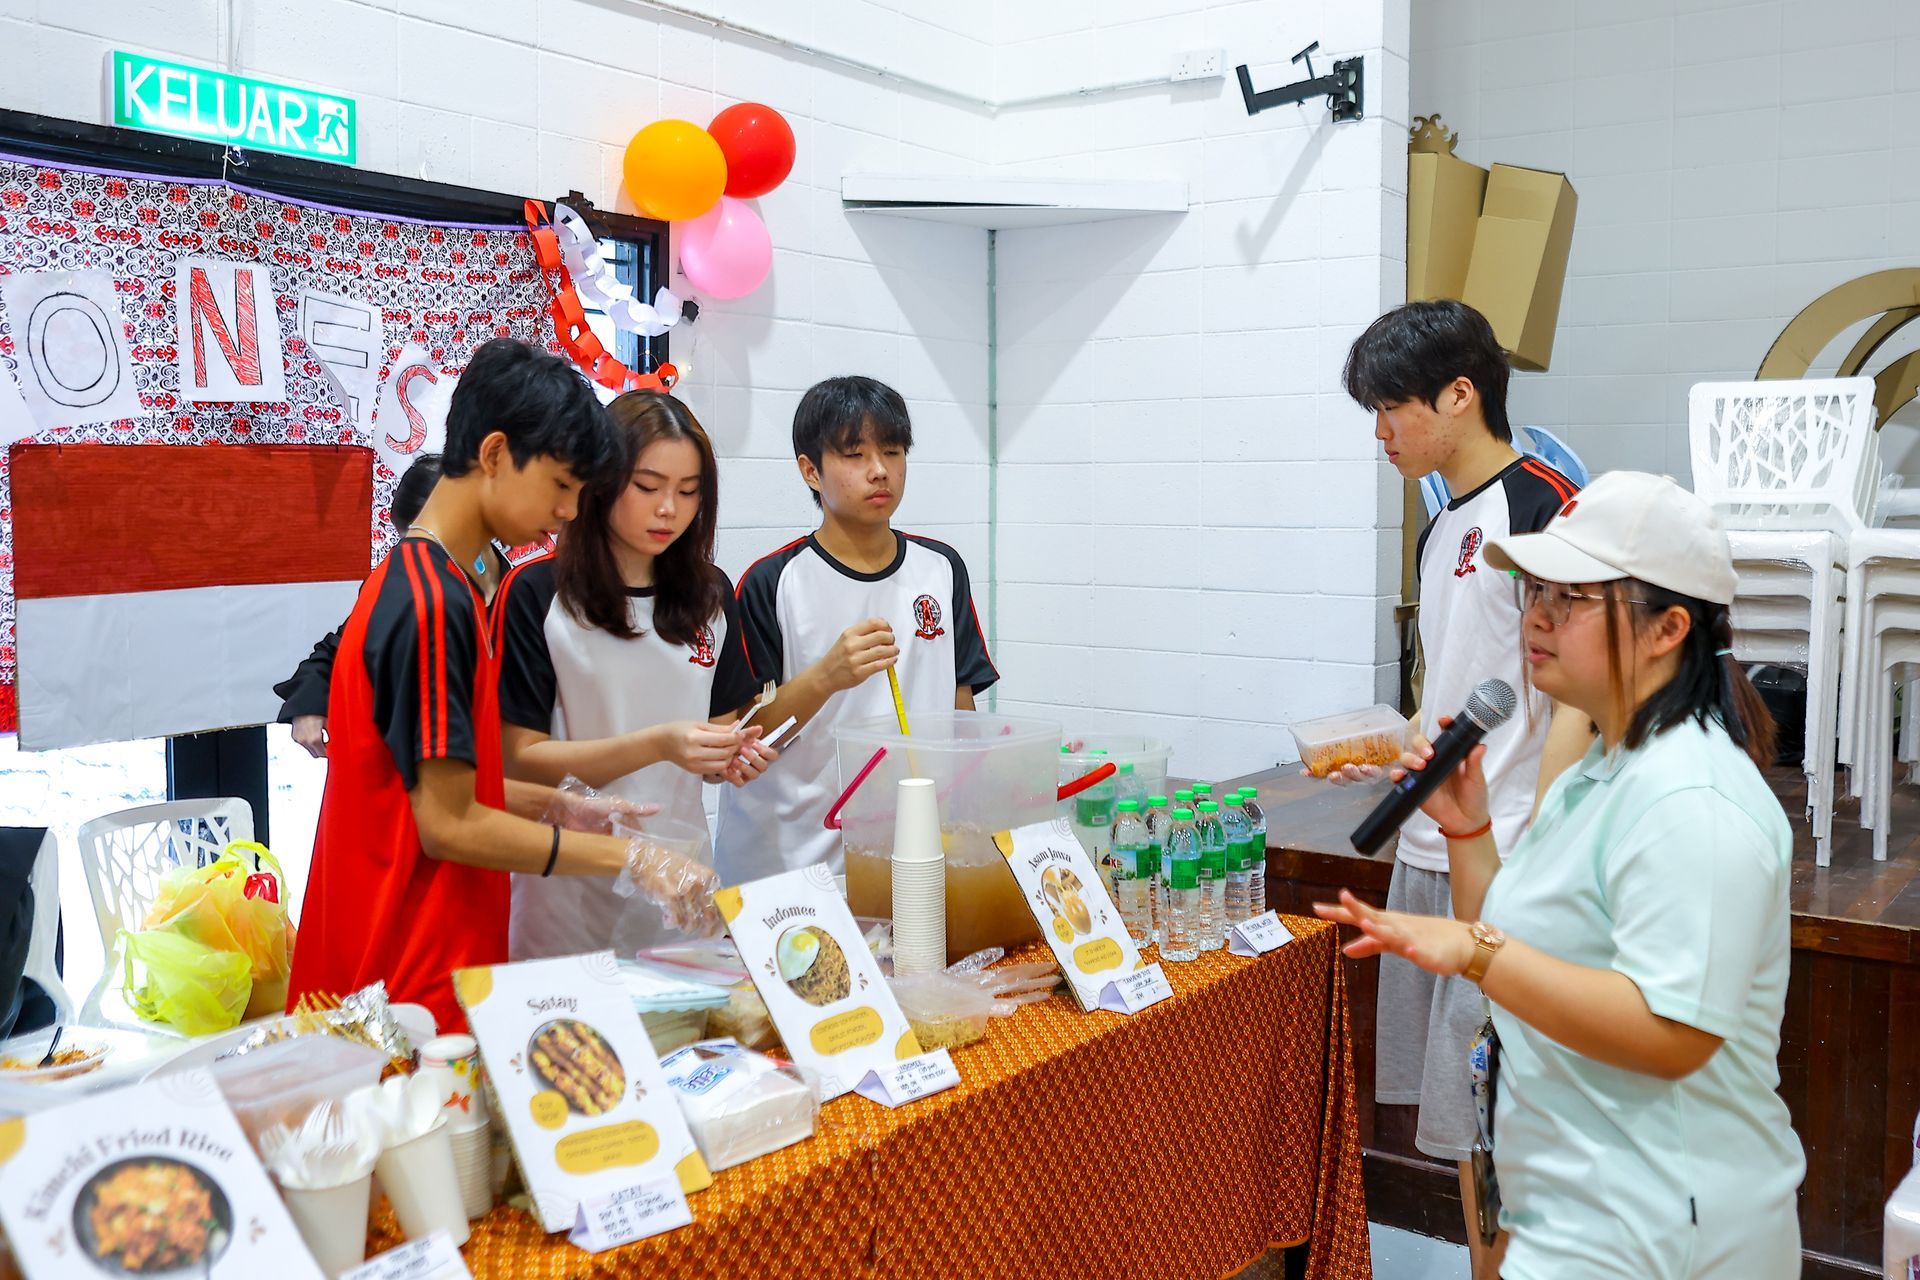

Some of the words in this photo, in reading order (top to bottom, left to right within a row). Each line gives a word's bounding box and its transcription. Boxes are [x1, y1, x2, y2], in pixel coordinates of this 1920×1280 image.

[123, 60, 307, 150] KELUAR
[1028, 850, 1050, 873] Asam
[762, 904, 816, 930] Indomee
[526, 995, 578, 1016] Satay
[97, 1127, 171, 1156] Fried
[180, 1129, 233, 1162] Rice
[610, 1184, 642, 1205] SATAY
